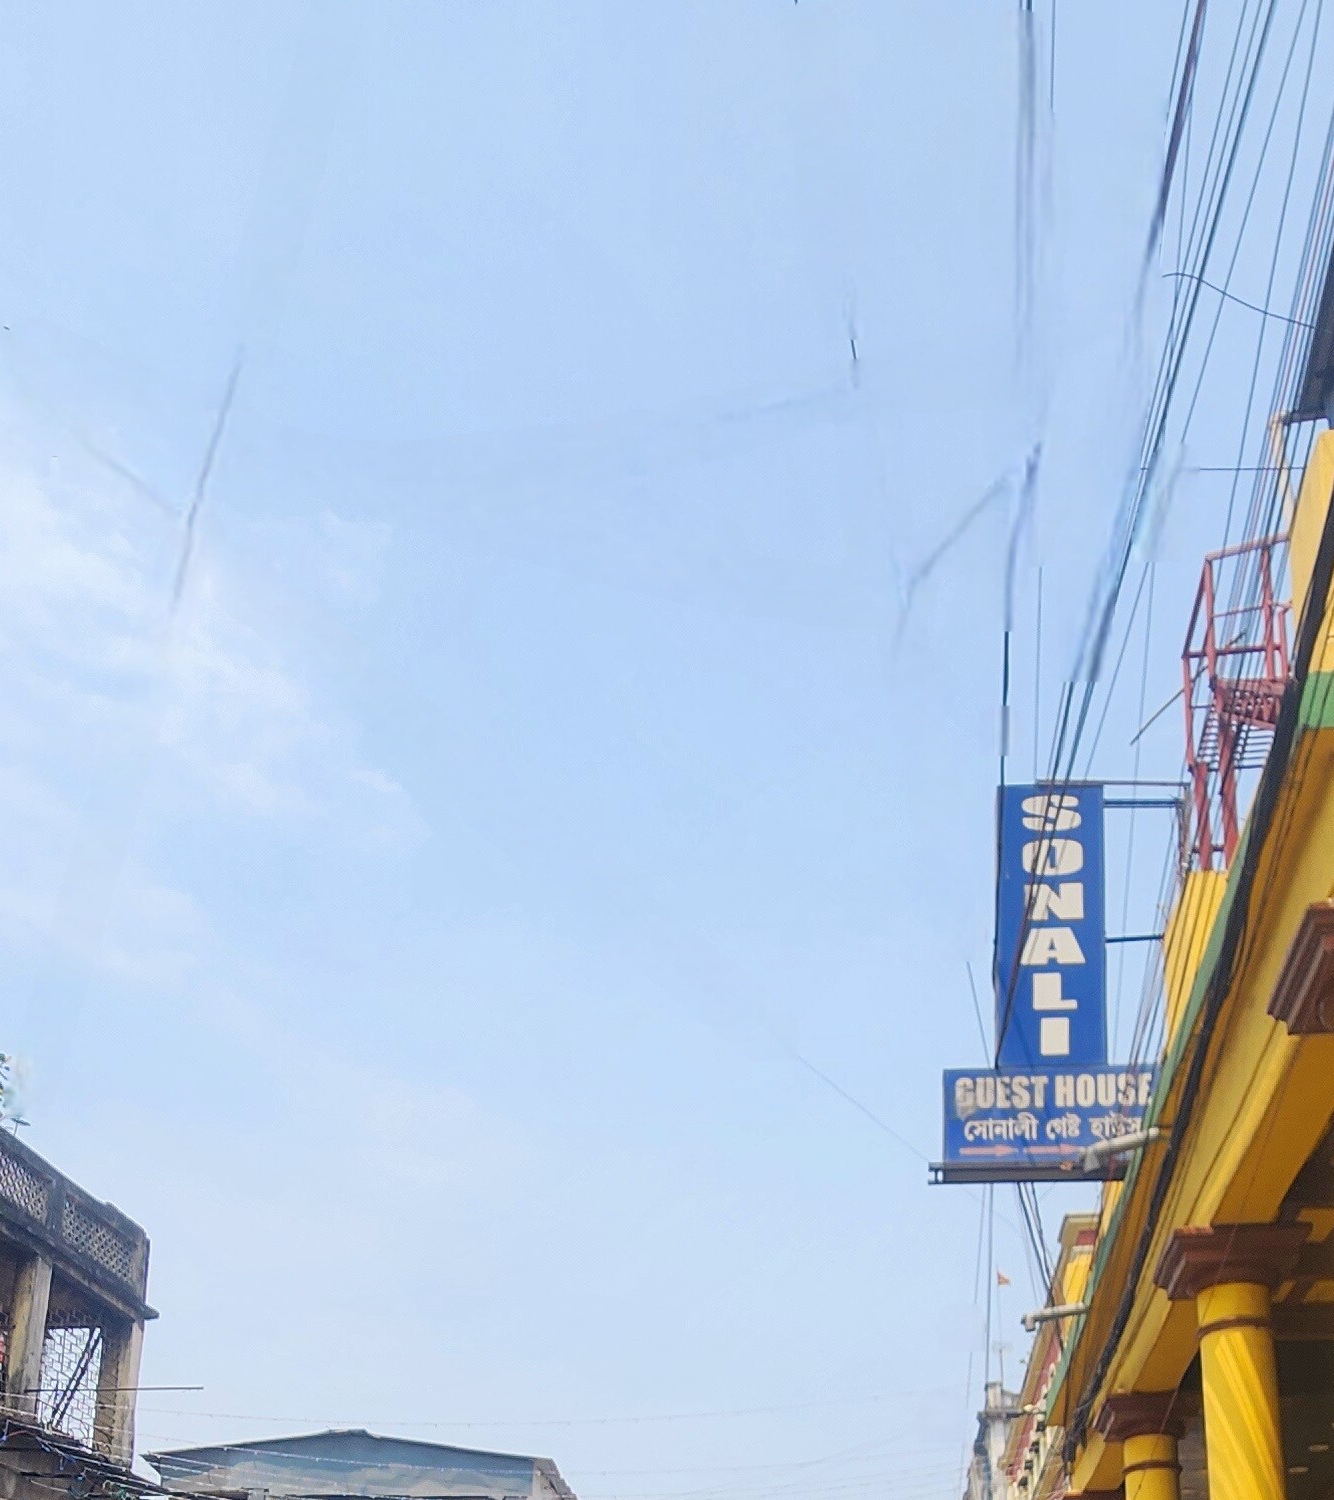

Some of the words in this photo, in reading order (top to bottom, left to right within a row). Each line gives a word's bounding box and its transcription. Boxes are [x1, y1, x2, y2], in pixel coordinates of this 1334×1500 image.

[1019, 794, 1085, 1057] SONALI
[955, 1075, 1049, 1109] GUEST
[1054, 1072, 1152, 1108] HOUSE
